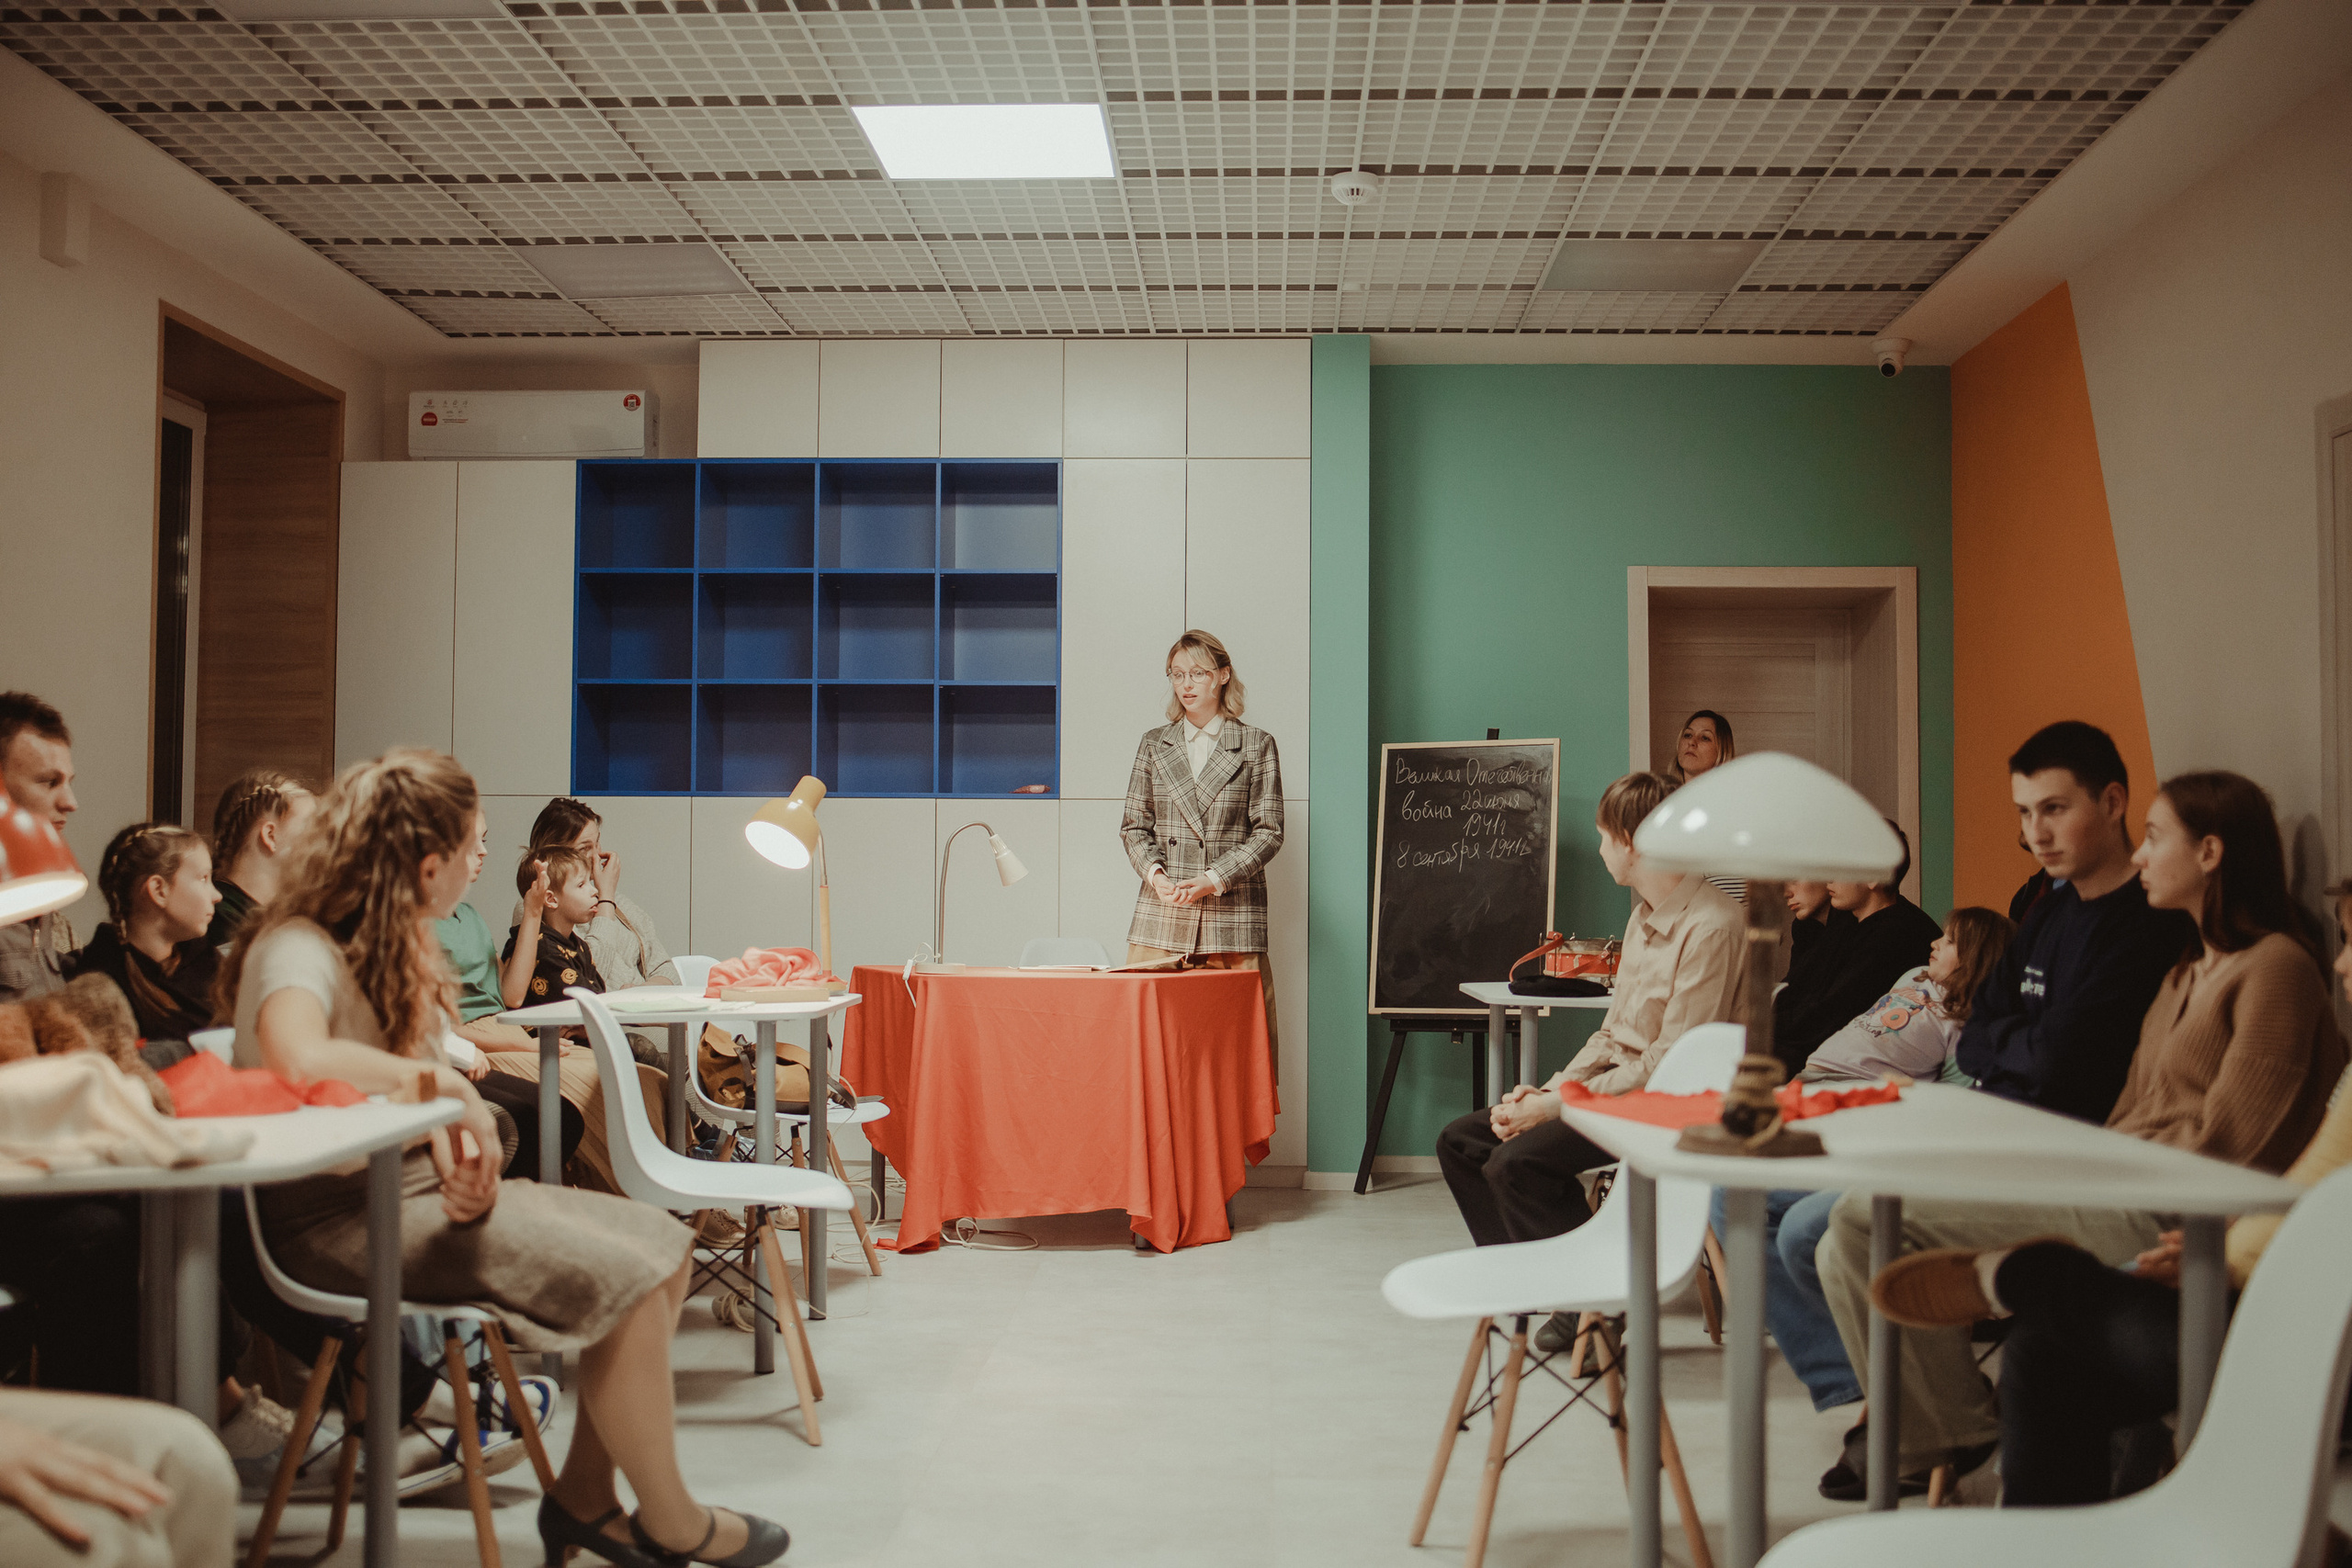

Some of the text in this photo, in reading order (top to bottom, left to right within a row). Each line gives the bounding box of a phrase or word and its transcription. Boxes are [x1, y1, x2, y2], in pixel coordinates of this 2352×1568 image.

[1395, 756, 1461, 784] Великая
[1401, 789, 1453, 822] война
[1396, 840, 1410, 869] 8
[1412, 838, 1480, 874] сентября
